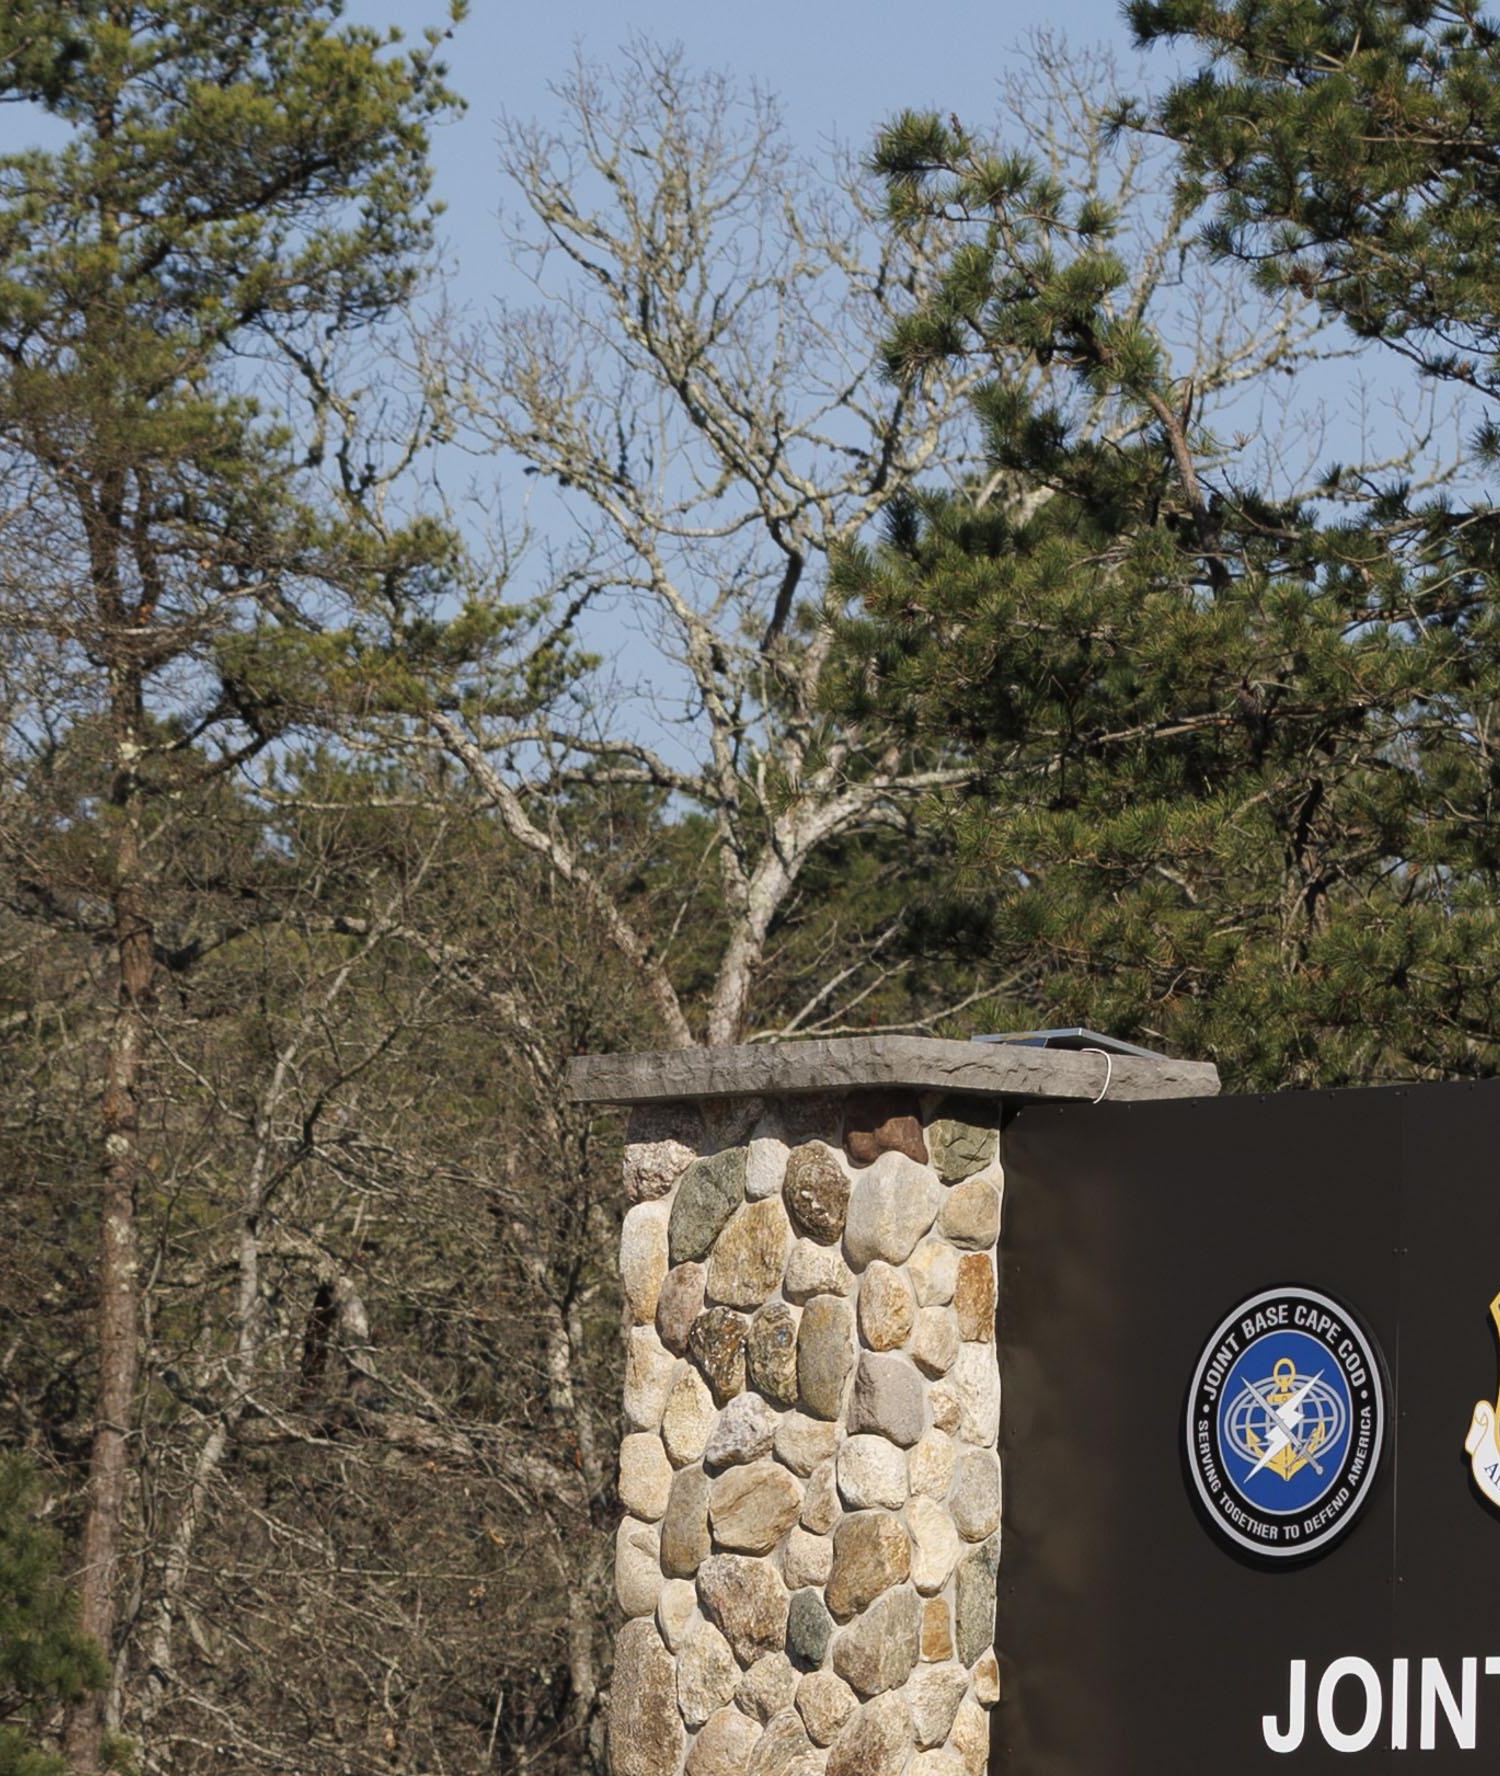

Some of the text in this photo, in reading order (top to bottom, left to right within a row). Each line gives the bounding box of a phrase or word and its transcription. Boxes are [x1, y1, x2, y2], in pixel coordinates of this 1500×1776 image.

[1203, 1304, 1367, 1401] JOINT BASE CAPE COD
[1199, 1406, 1371, 1540] SERVING TOGETHER TO DEFEND AMERICA
